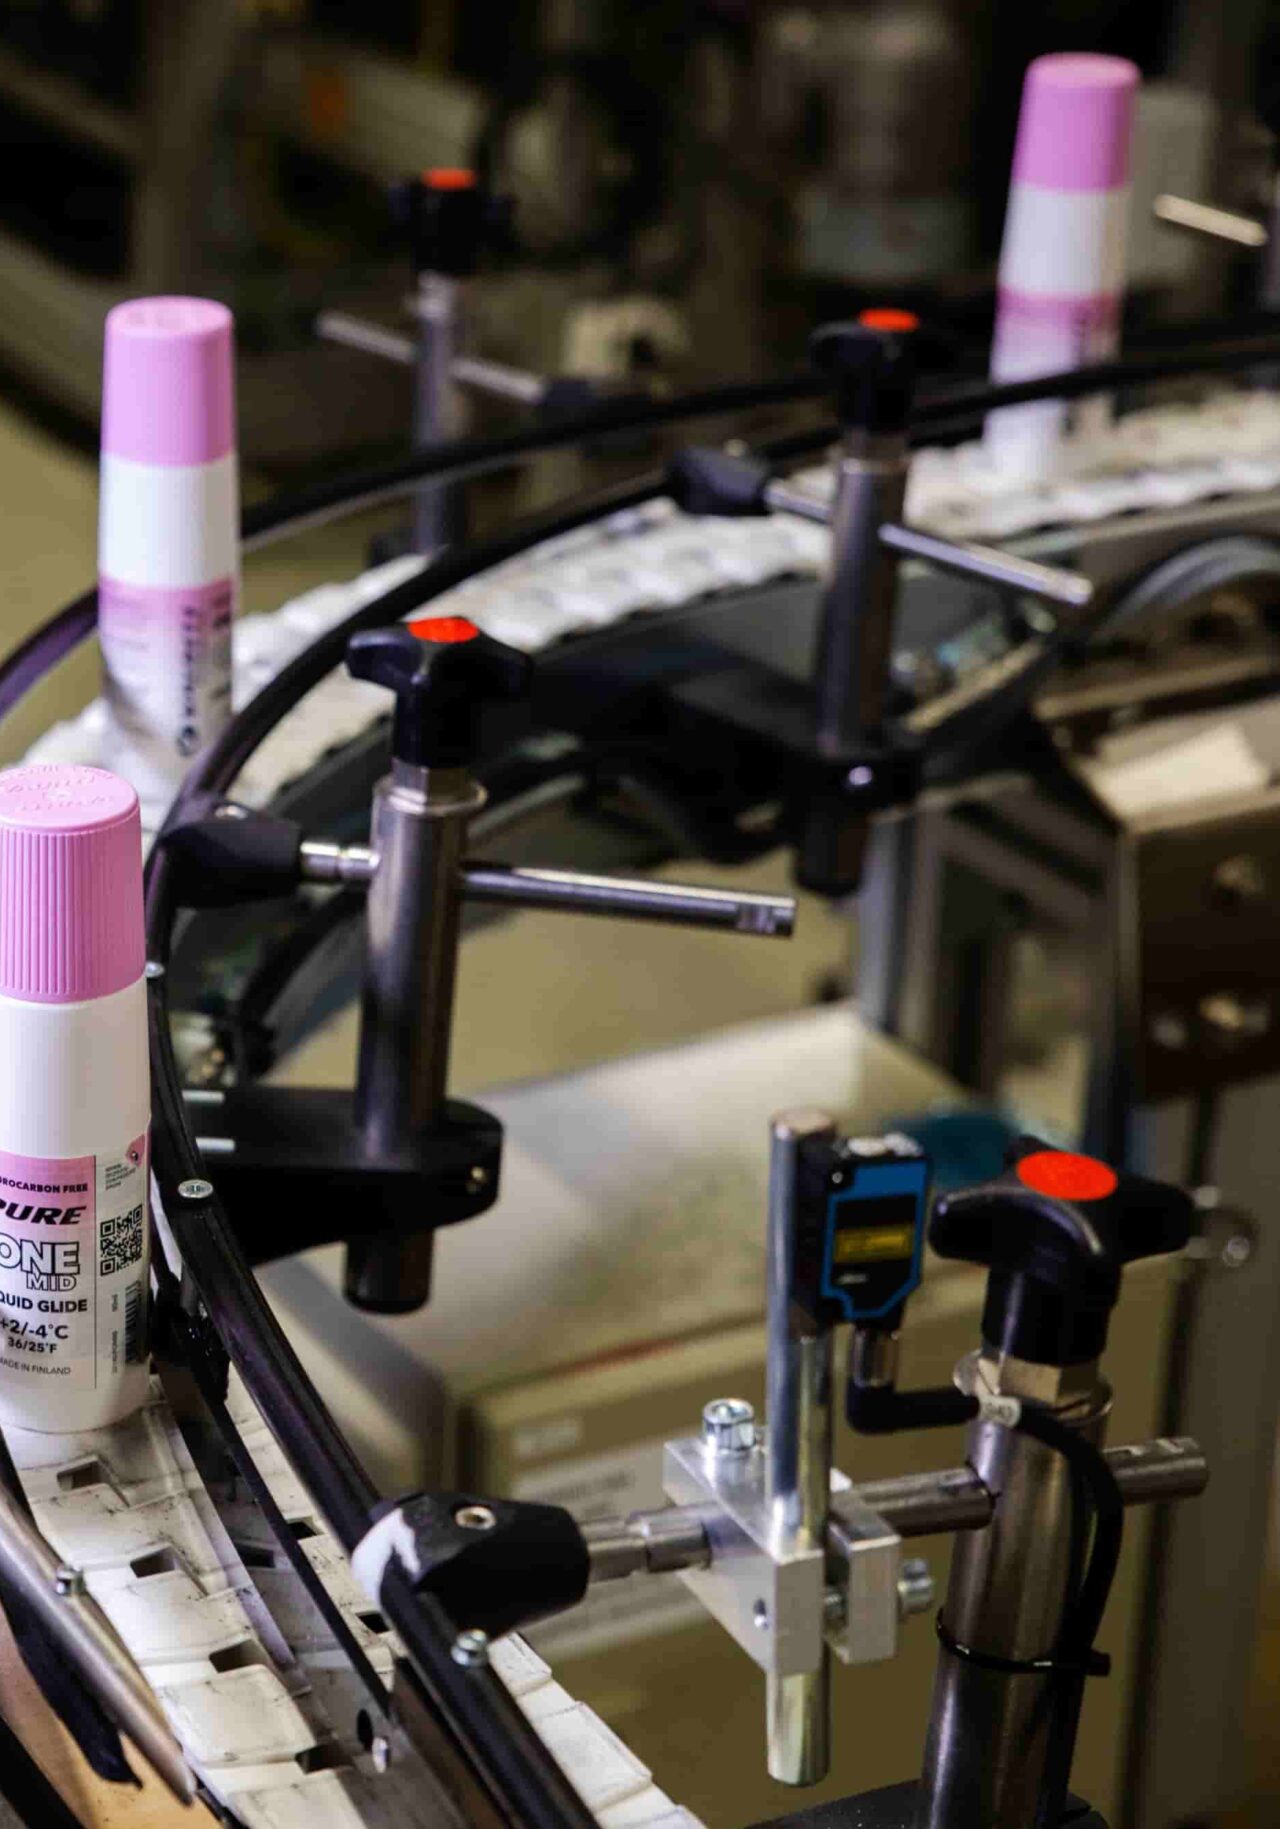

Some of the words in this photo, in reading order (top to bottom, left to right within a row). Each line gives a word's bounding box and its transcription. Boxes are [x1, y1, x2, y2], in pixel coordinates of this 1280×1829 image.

[62, 1183, 88, 1193] FREE
[26, 1271, 77, 1292] MID
[37, 1299, 88, 1313] GLIDE
[21, 1363, 30, 1373] IN
[32, 1364, 72, 1375] FINLAND
